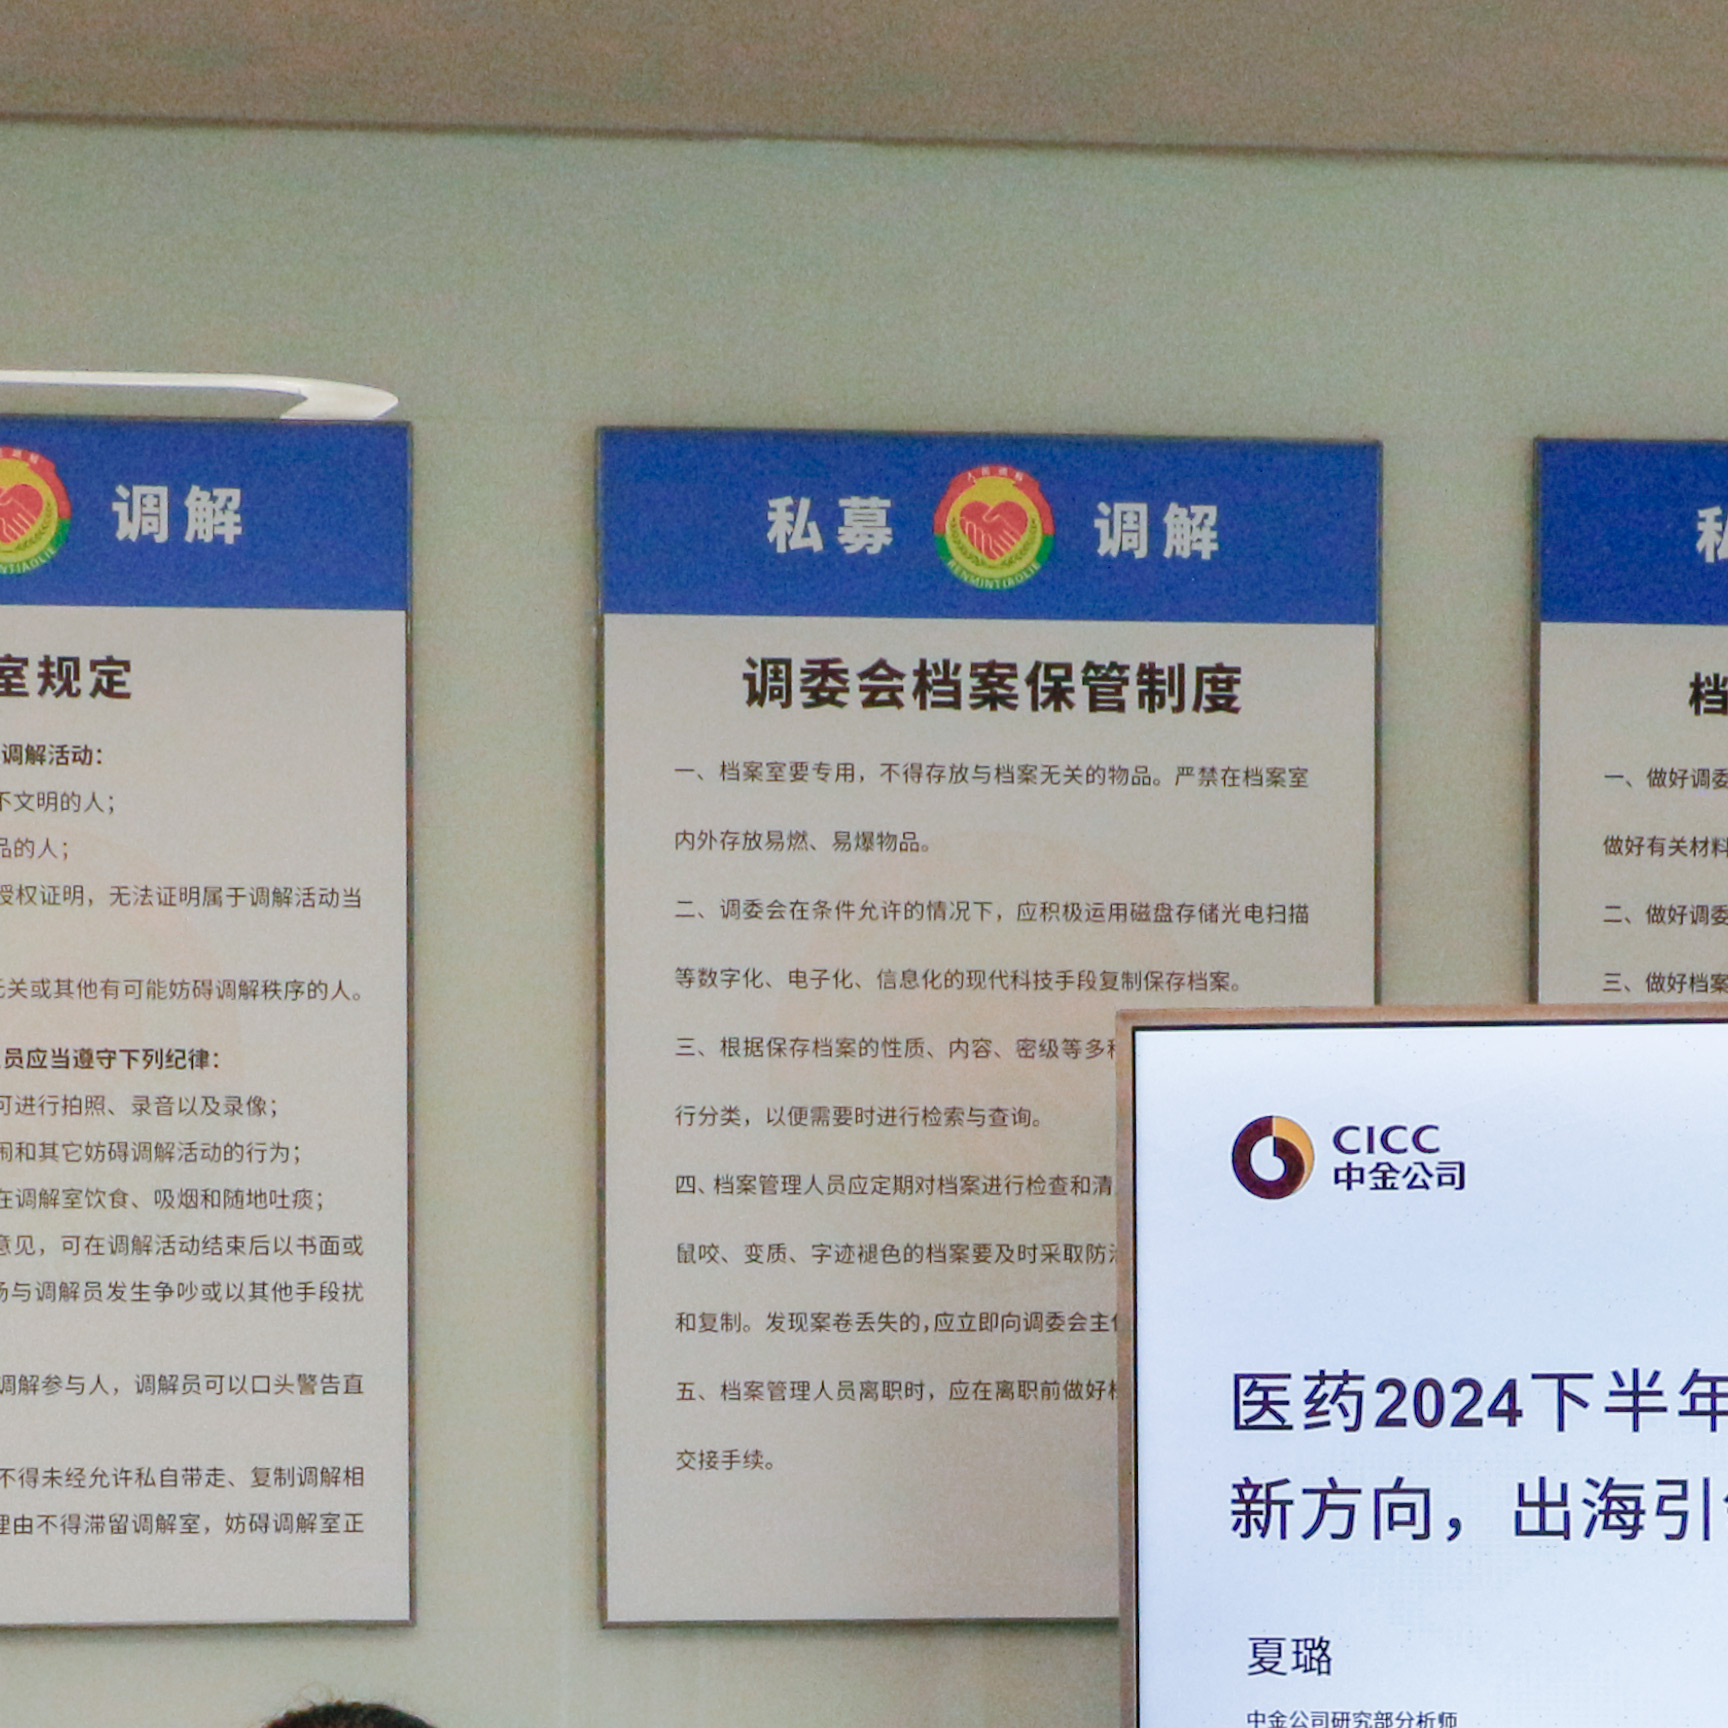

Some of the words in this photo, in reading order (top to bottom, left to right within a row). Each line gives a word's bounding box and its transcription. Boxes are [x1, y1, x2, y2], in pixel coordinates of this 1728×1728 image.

[112, 485, 242, 544] 调解
[767, 496, 892, 554] 私募
[1094, 502, 1218, 560] 调解
[742, 657, 1242, 715] 调委会档案保管制度
[1333, 1124, 1440, 1155] CICC
[1333, 1160, 1465, 1192] 中金公司
[676, 1311, 1117, 1334] 和复制。发现案卷丢失的，应立即向调委会主
[677, 1449, 776, 1472] 交接手续。
[1247, 1636, 1332, 1677] 夏璐
